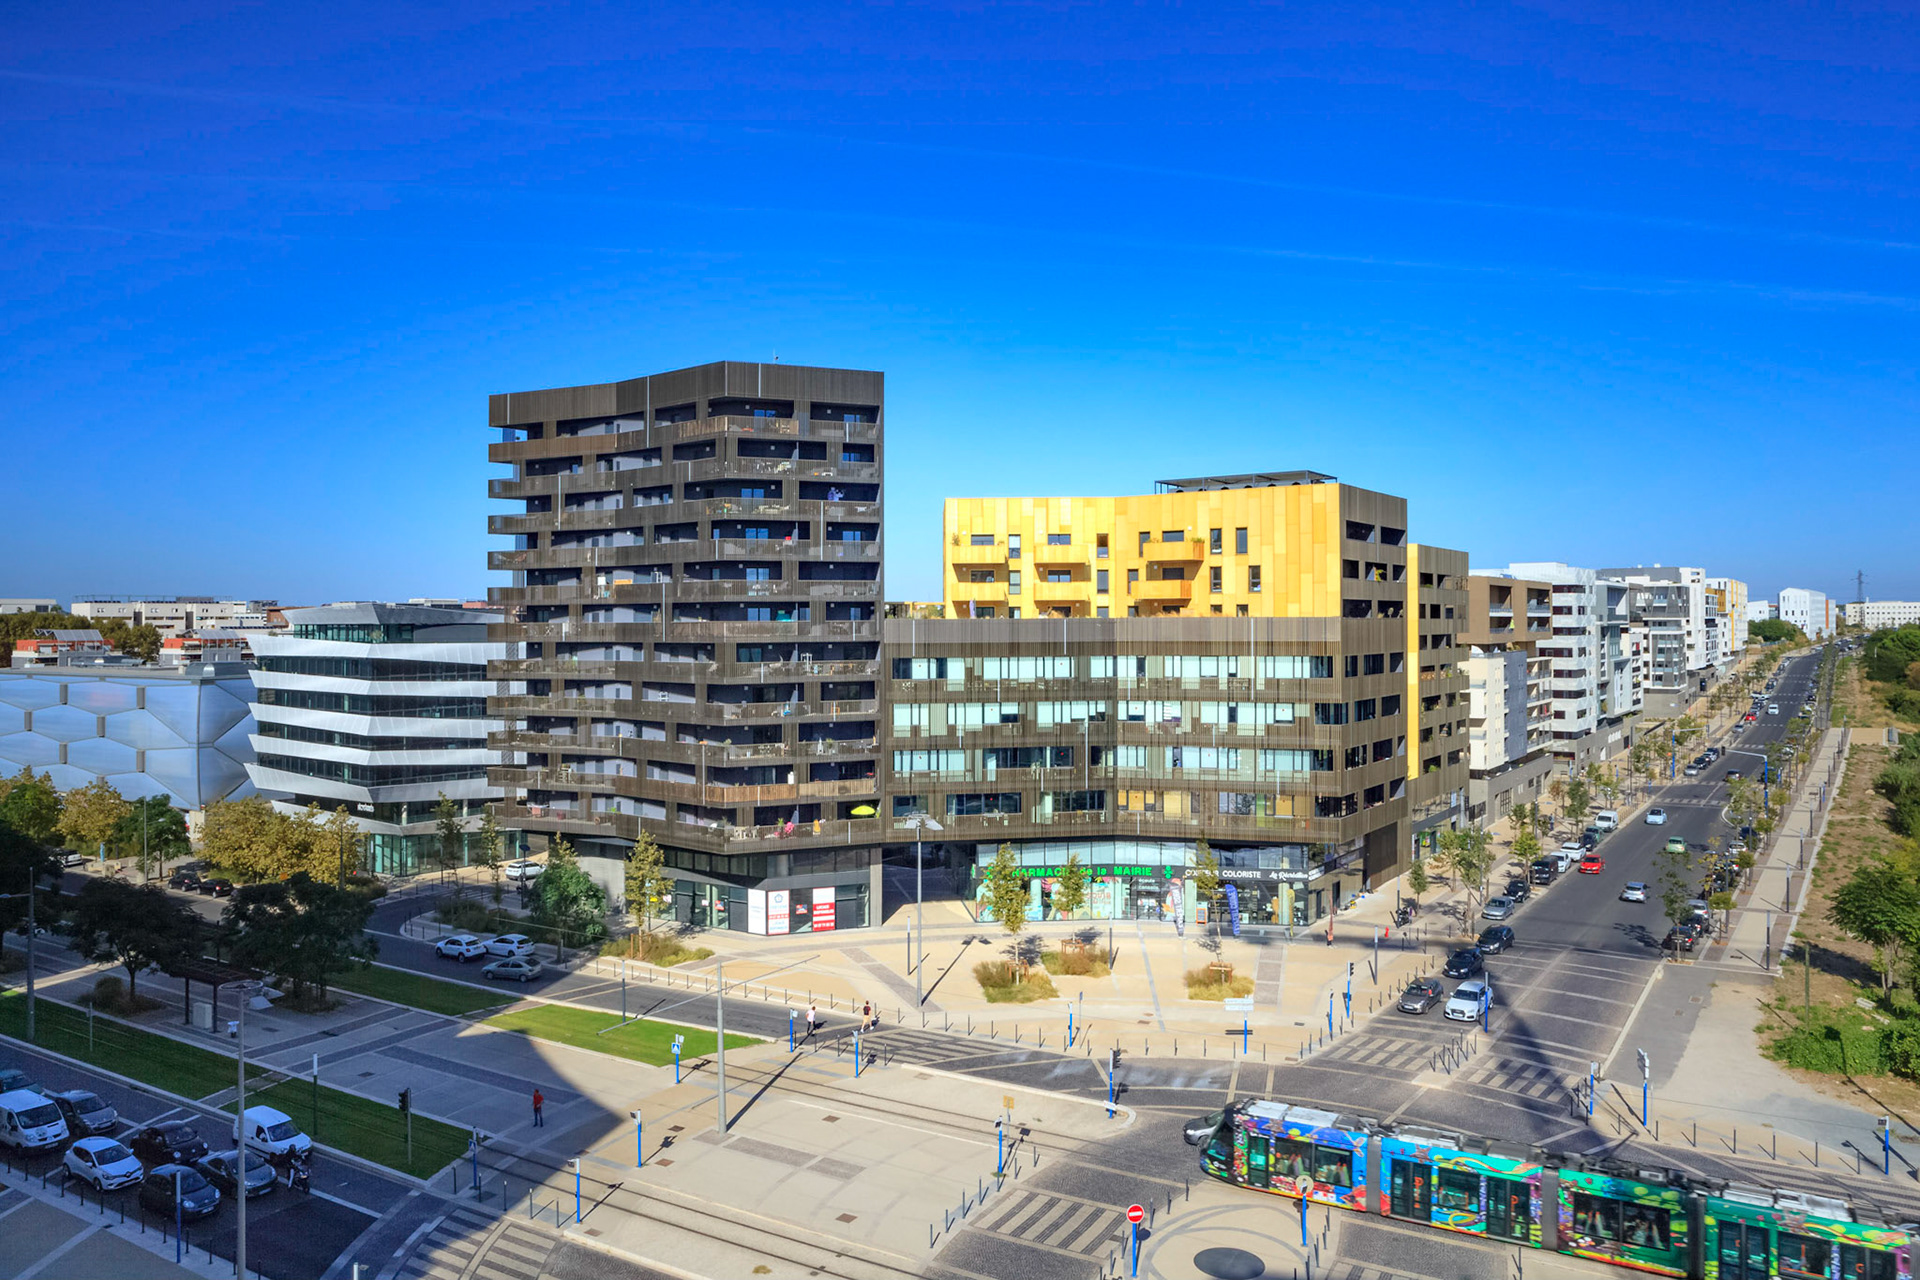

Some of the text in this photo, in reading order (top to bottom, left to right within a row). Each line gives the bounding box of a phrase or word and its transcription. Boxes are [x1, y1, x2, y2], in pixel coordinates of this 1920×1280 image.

[1006, 868, 1070, 878] HARMACI
[1097, 867, 1107, 876] la
[1113, 866, 1152, 876] MAIRIE
[1222, 870, 1262, 879] COLORISTE
